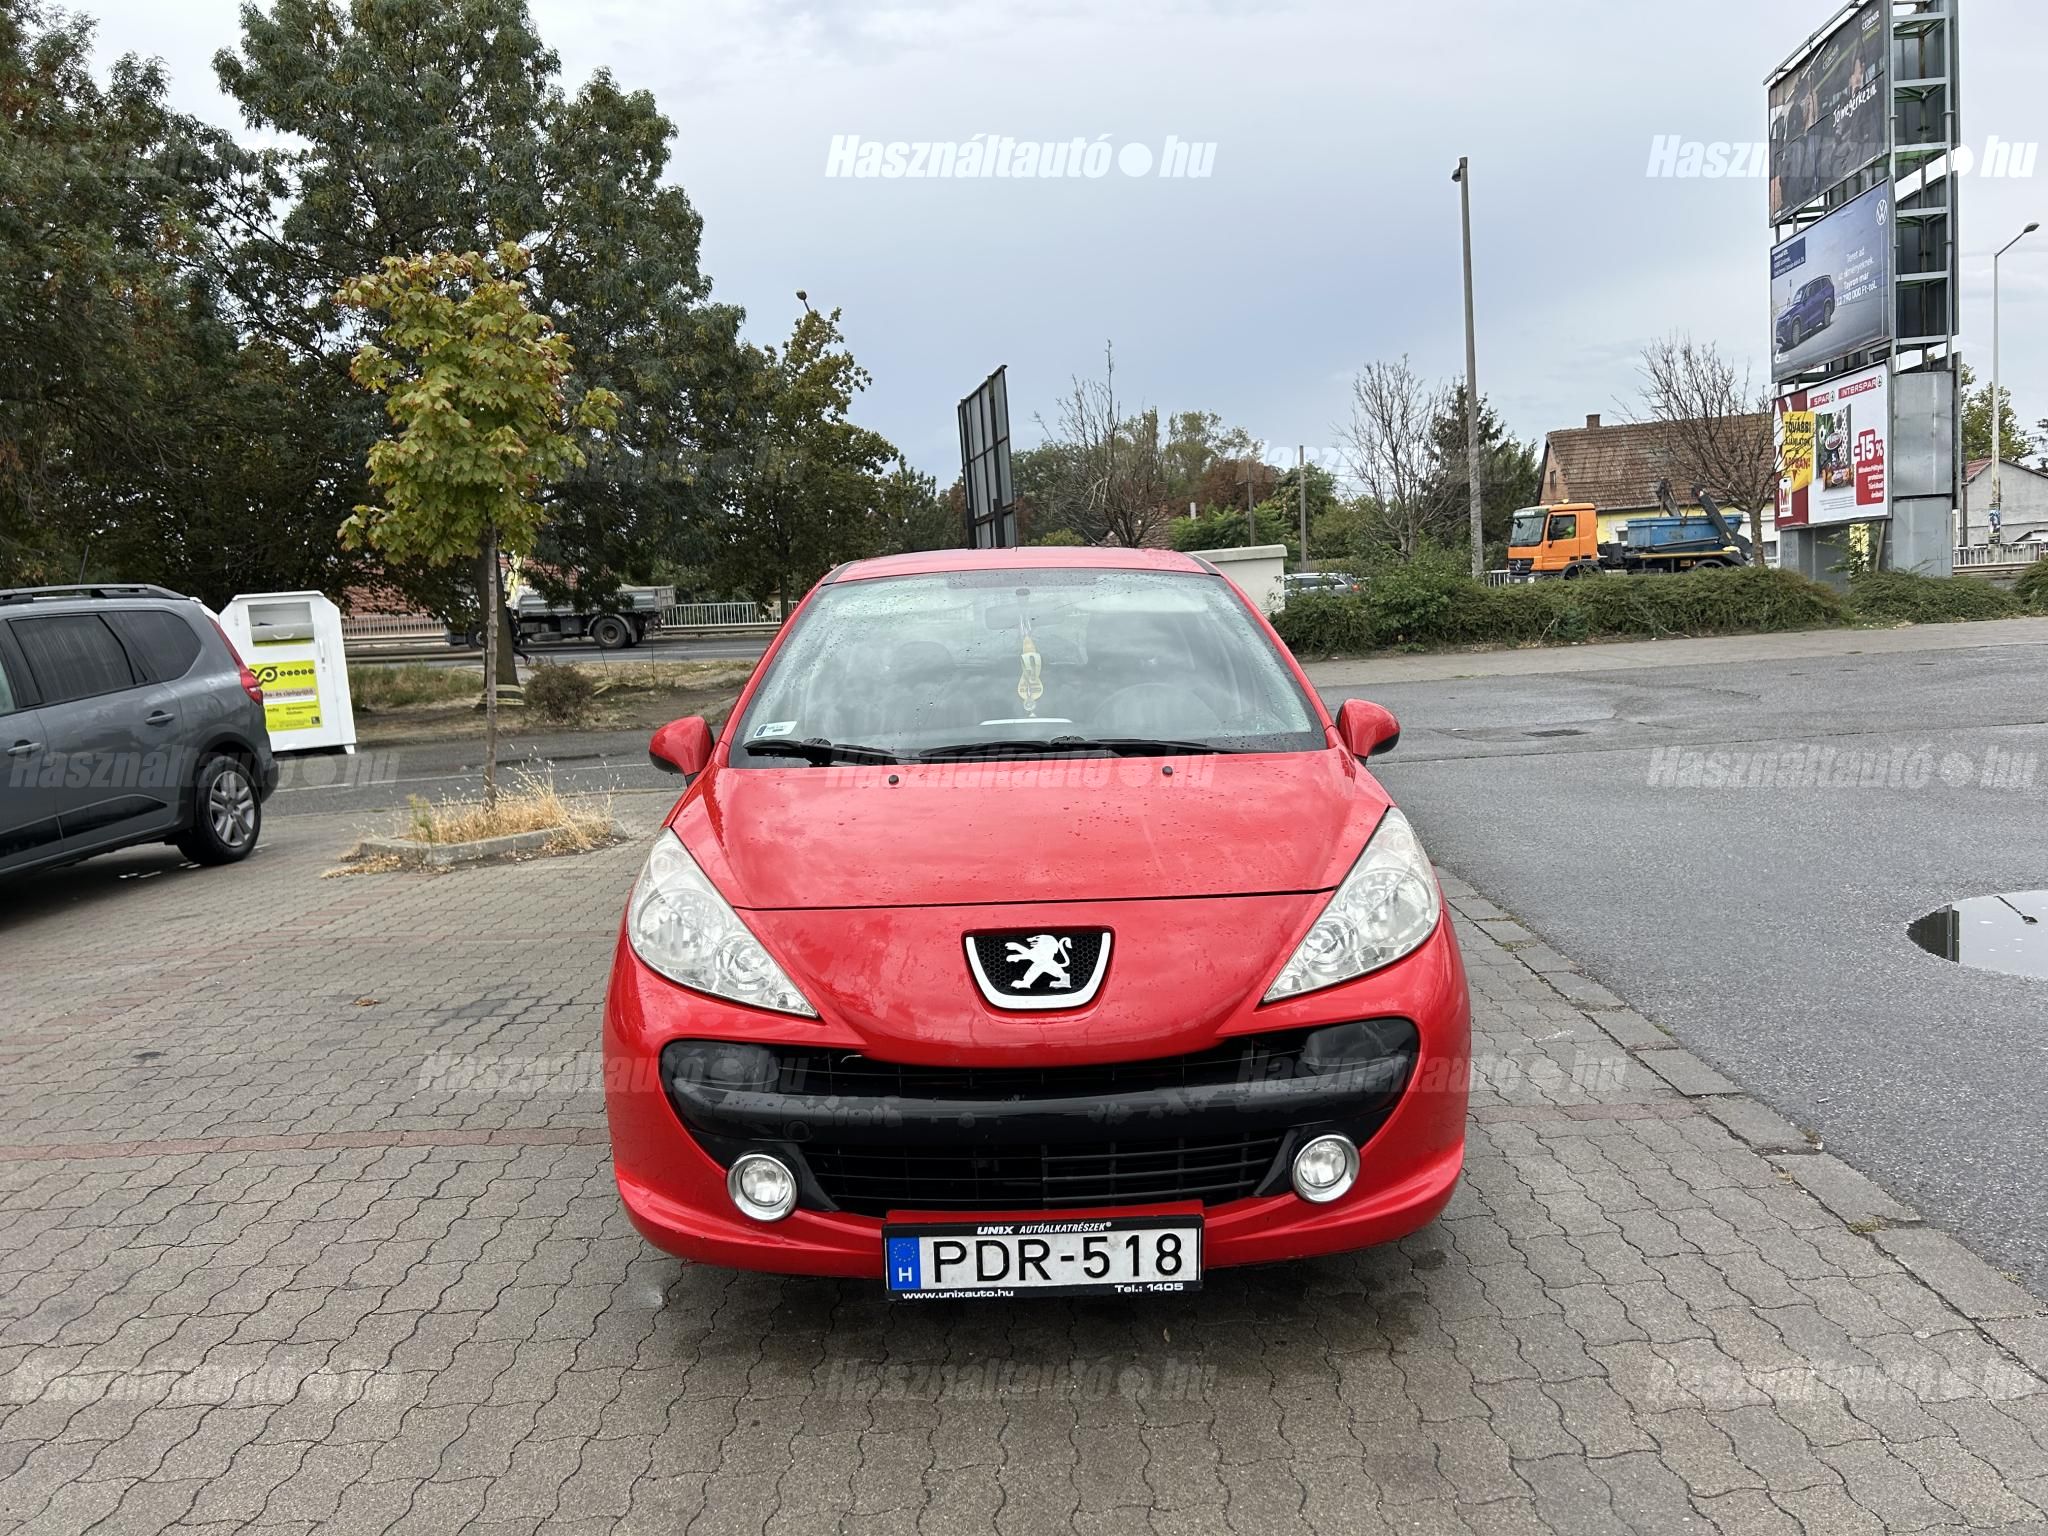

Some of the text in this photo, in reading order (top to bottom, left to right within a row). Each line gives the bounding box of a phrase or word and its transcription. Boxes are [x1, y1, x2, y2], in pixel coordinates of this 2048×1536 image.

[1841, 377, 1876, 397] INTERSPAR
[1813, 394, 1830, 406] SPAR
[977, 1225, 1014, 1235] UNIX
[932, 1233, 1182, 1283] PDR-518
[898, 1267, 912, 1282] H
[902, 1288, 1014, 1299] www.unixauto.hu
[1115, 1282, 1183, 1293] Tel.: 1405
